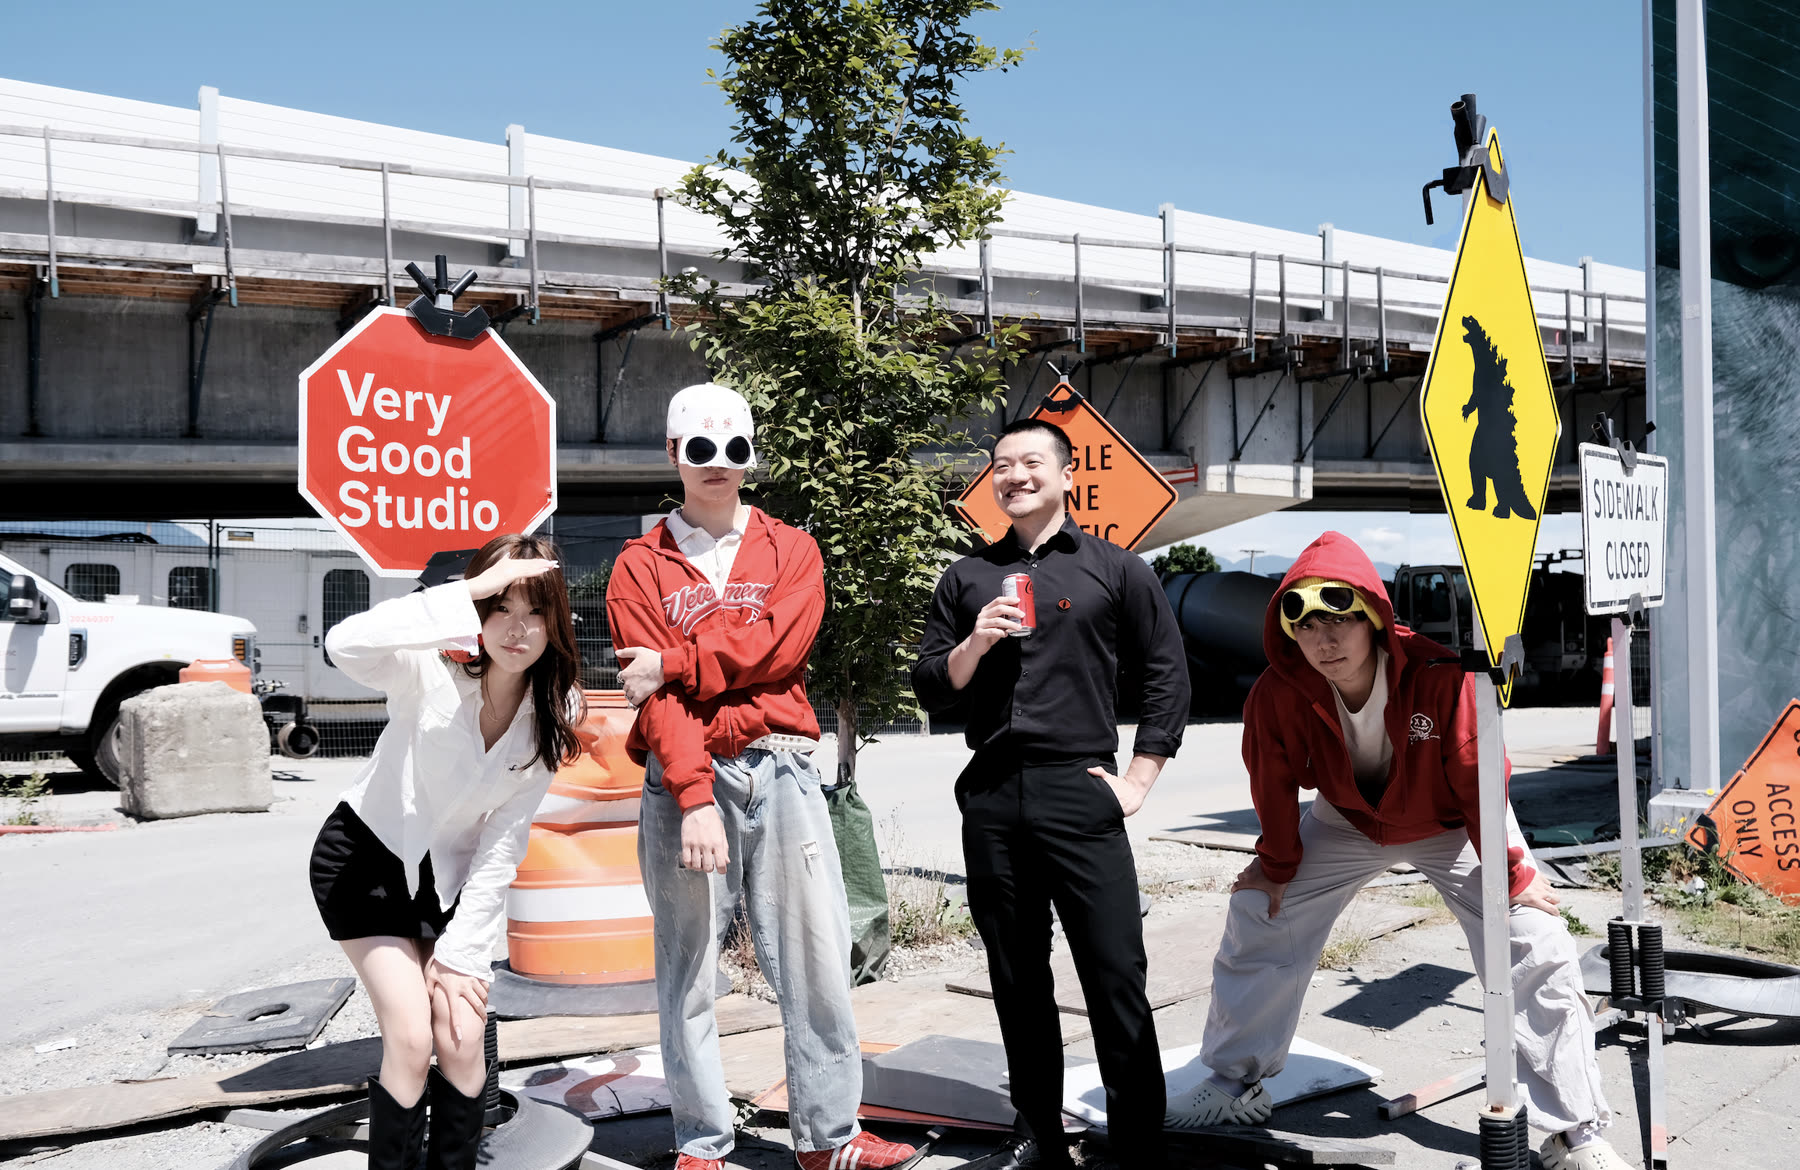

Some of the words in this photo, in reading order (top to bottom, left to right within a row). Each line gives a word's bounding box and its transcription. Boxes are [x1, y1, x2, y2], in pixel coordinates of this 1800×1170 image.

[337, 369, 452, 436] Very
[337, 425, 472, 479] Good
[1071, 444, 1113, 472] GLE
[338, 480, 500, 532] Studio
[1064, 485, 1099, 511] NE
[1593, 478, 1659, 521] SIDEWALK
[1606, 541, 1651, 580] CLOSED
[1732, 800, 1763, 858] ONLY
[1766, 783, 1800, 871] ACCESS
